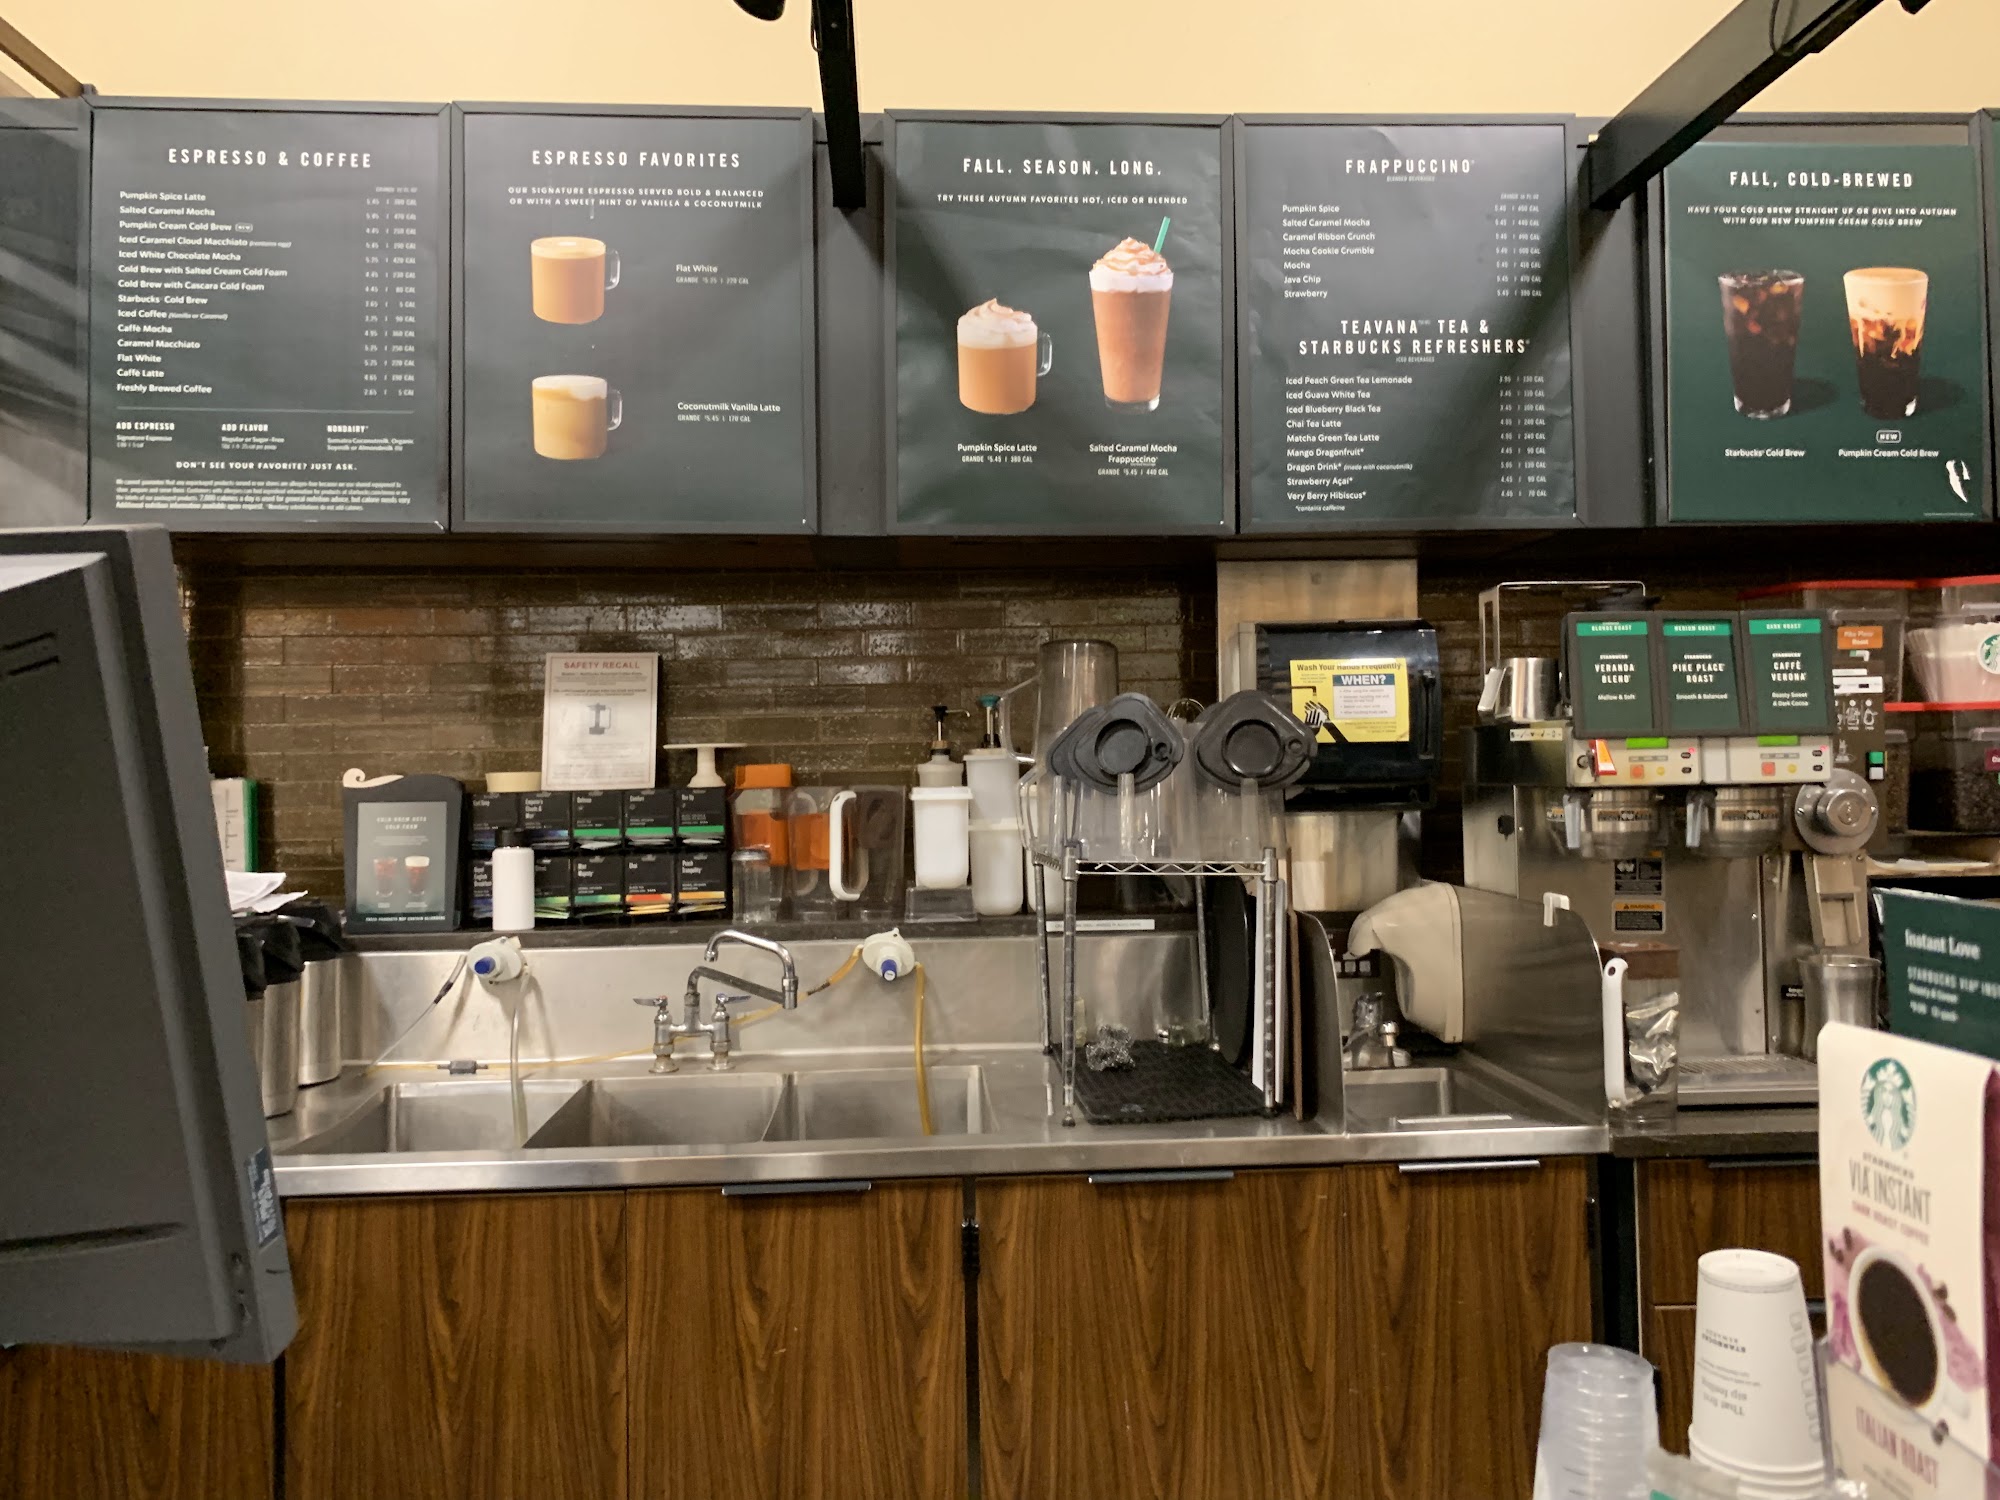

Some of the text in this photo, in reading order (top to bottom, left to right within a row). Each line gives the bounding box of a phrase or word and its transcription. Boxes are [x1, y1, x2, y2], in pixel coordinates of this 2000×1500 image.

[169, 148, 370, 168] ESPRESSO & COFFEE
[533, 150, 739, 168] ESPRESSO FAVORITES
[964, 158, 1161, 175] FALL. SEASON. LONG.
[1345, 158, 1470, 173] FRAPPUCCINO
[1730, 171, 1912, 188] FALL, COLD-BREWED
[120, 191, 206, 201] Pumpkin Spice Latte
[588, 187, 634, 195] ESPRESSO
[677, 188, 701, 196] BOLD
[715, 189, 763, 197] BALANCED
[641, 199, 680, 207] VANILLA
[694, 200, 761, 208] COCONUTMILK
[937, 194, 953, 202] TRY
[957, 194, 984, 202] THESE
[988, 195, 1026, 203] AUTUMN
[1030, 195, 1078, 204] FAVORITES
[1082, 196, 1103, 204] HOT,
[1107, 196, 1128, 204] ICED
[1132, 196, 1144, 204] OR
[119, 206, 215, 216] Salted Caramel Mocha
[1282, 204, 1340, 214] Pumpkin Spice
[1740, 206, 1764, 214] COLD
[1856, 207, 1869, 215] OR
[1872, 207, 1892, 215] DIVE
[1919, 208, 1956, 216] AUTUMN
[119, 220, 232, 231] Pumpkin Cream Cold Brew
[1283, 218, 1370, 227] Salted Caramel Mocha
[1283, 232, 1375, 241] Caramel Ribbon Crunch
[676, 264, 718, 272] Flat White
[118, 279, 264, 291] Cold Brew with Cascara Cold Foam
[1284, 289, 1328, 299] Strawberry
[117, 324, 172, 333] Caffè Mocha
[1340, 319, 1488, 334] TEAVANA TEA &
[117, 339, 200, 348] Caramel Macchiato
[1299, 339, 1524, 355] STARBUCKS REFRESHERS
[117, 354, 161, 363] Flat White
[1286, 375, 1412, 385] Iced Peach Green Tea Lemonade
[117, 383, 212, 393] Freshly Brewed Coffee
[677, 402, 781, 412] Coconutmilk Vanilla Latte
[1286, 434, 1316, 442] Matcha
[1318, 434, 1342, 442] Green
[1344, 433, 1357, 441] Tea
[957, 443, 1037, 453] Pumpkin Spice Latte
[1089, 443, 1177, 452] Salted Caramel Mocha
[1287, 449, 1314, 458] Mango
[1838, 449, 1939, 458] Pumpkin Cream Cold Brew
[1108, 456, 1156, 464] Frappuccino
[258, 462, 307, 470] FAVORITE?
[1287, 492, 1305, 501] Very
[1307, 491, 1328, 501] Berry
[564, 661, 639, 669] SAFETY RECALL
[1595, 663, 1634, 672] VERANDA
[1672, 663, 1725, 672] PIKE PLACE
[1773, 660, 1801, 670] CAFFÈ
[1341, 674, 1386, 685] WHEN?
[1601, 674, 1630, 683] BLEND
[1686, 674, 1713, 683] ROAST
[1771, 673, 1806, 681] VERONA
[1905, 929, 1980, 959] Instant Love
[1849, 1160, 1870, 1197] VIA
[1874, 1172, 1930, 1224] INSTANT
[1856, 1407, 1897, 1459] ITALIAN
[1901, 1438, 1938, 1488] ROAST
